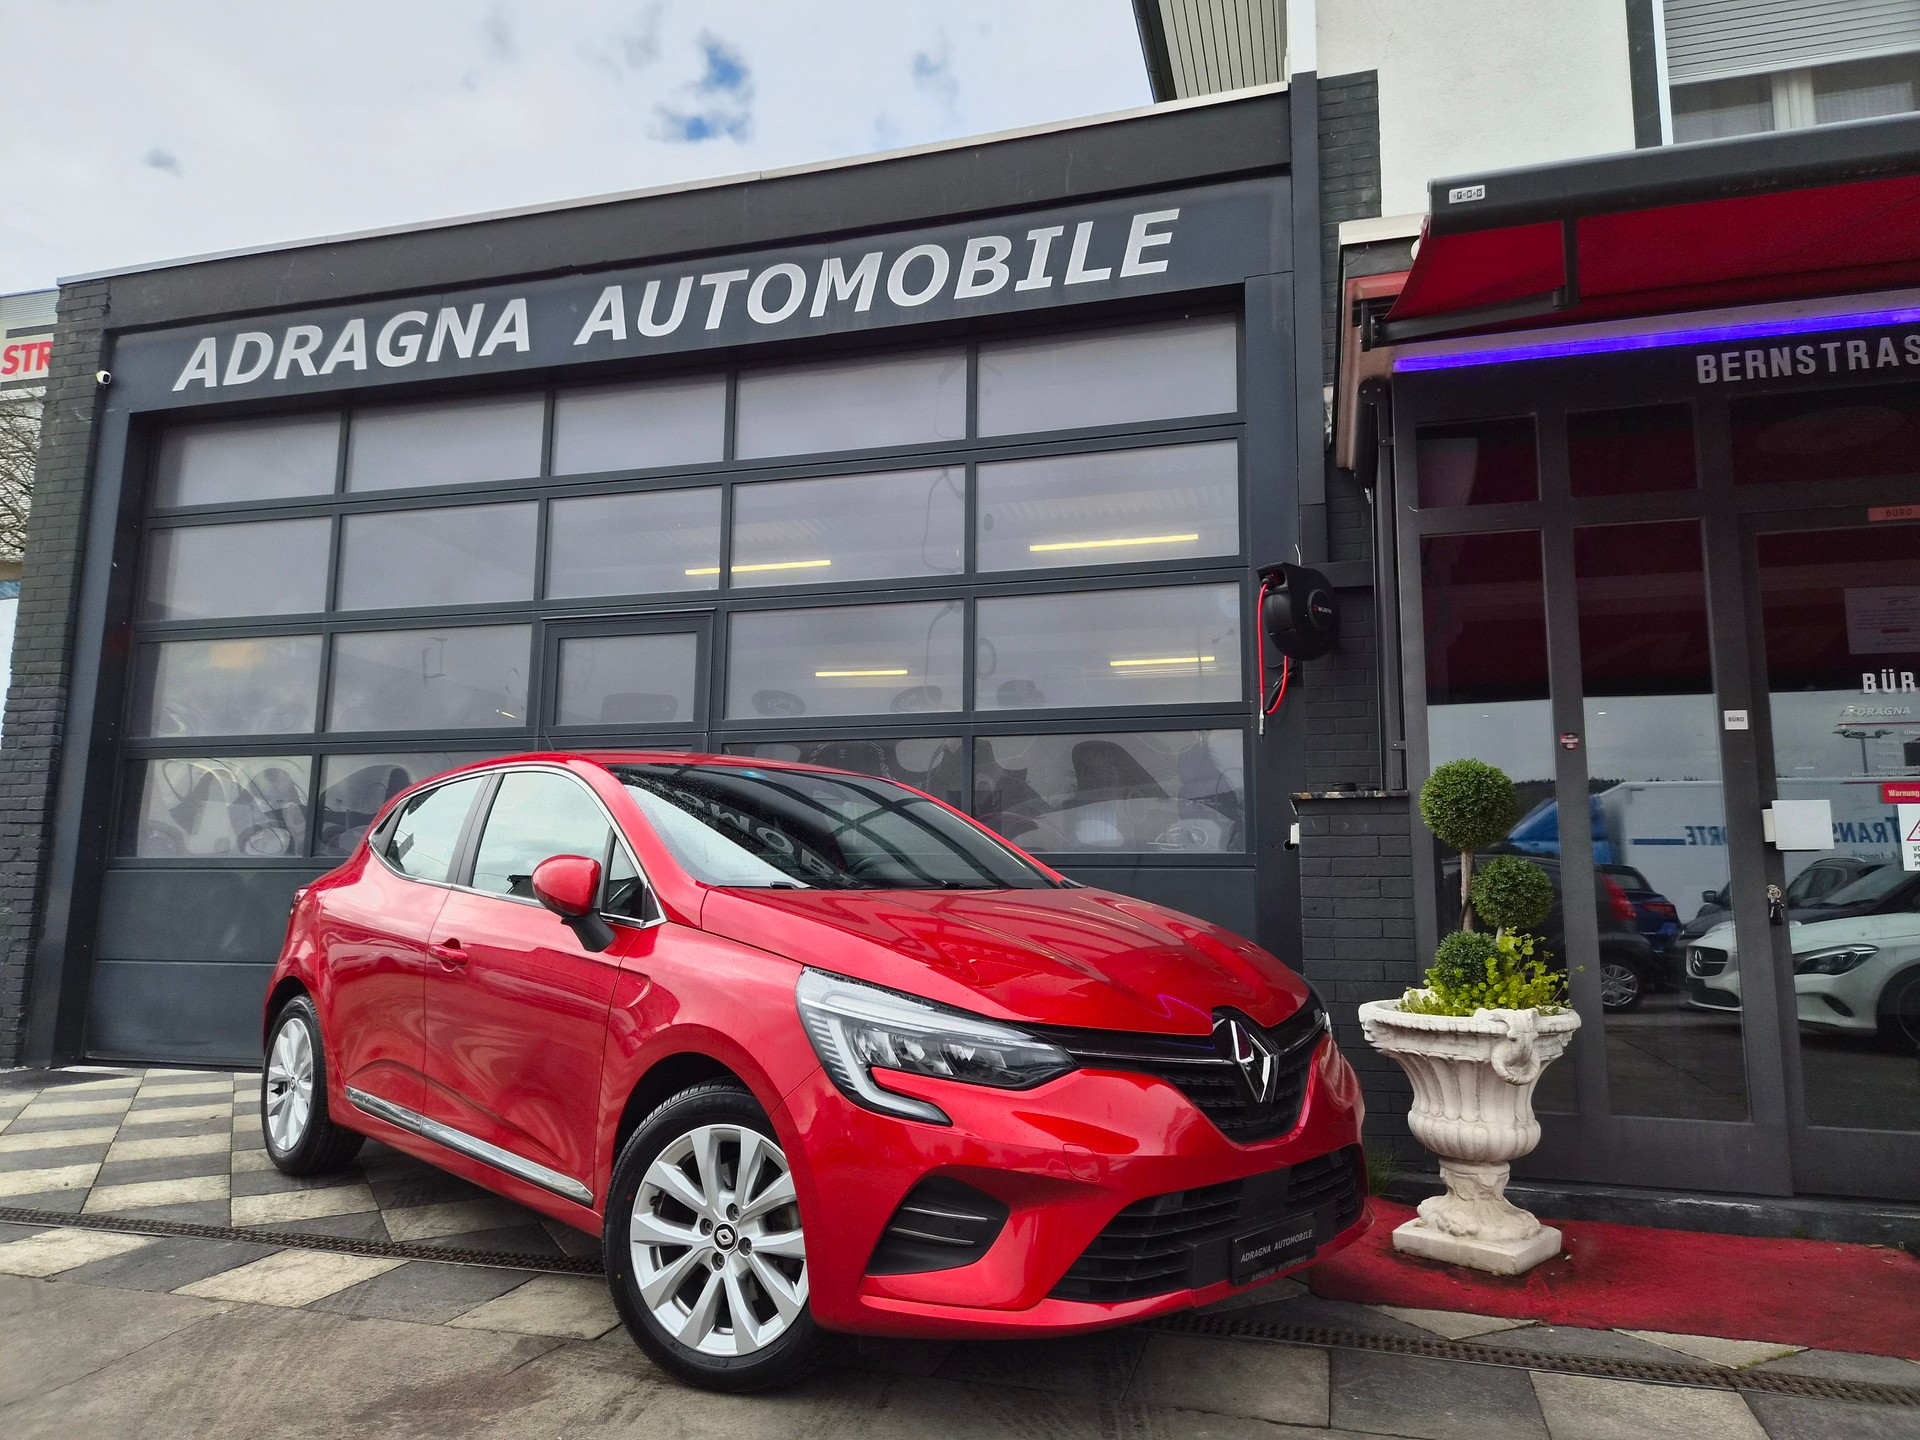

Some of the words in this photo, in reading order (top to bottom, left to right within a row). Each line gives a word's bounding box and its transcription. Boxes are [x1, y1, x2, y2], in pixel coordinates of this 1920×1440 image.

[172, 297, 531, 392] ADRAGNA
[573, 208, 1181, 345] AUTOMOBILE
[1696, 334, 1920, 384] BERNSTRAS
[1862, 669, 1916, 694] BÜR
[1240, 1244, 1271, 1263] ADRAGNA
[1273, 1229, 1313, 1251] AUTOMOBILE
